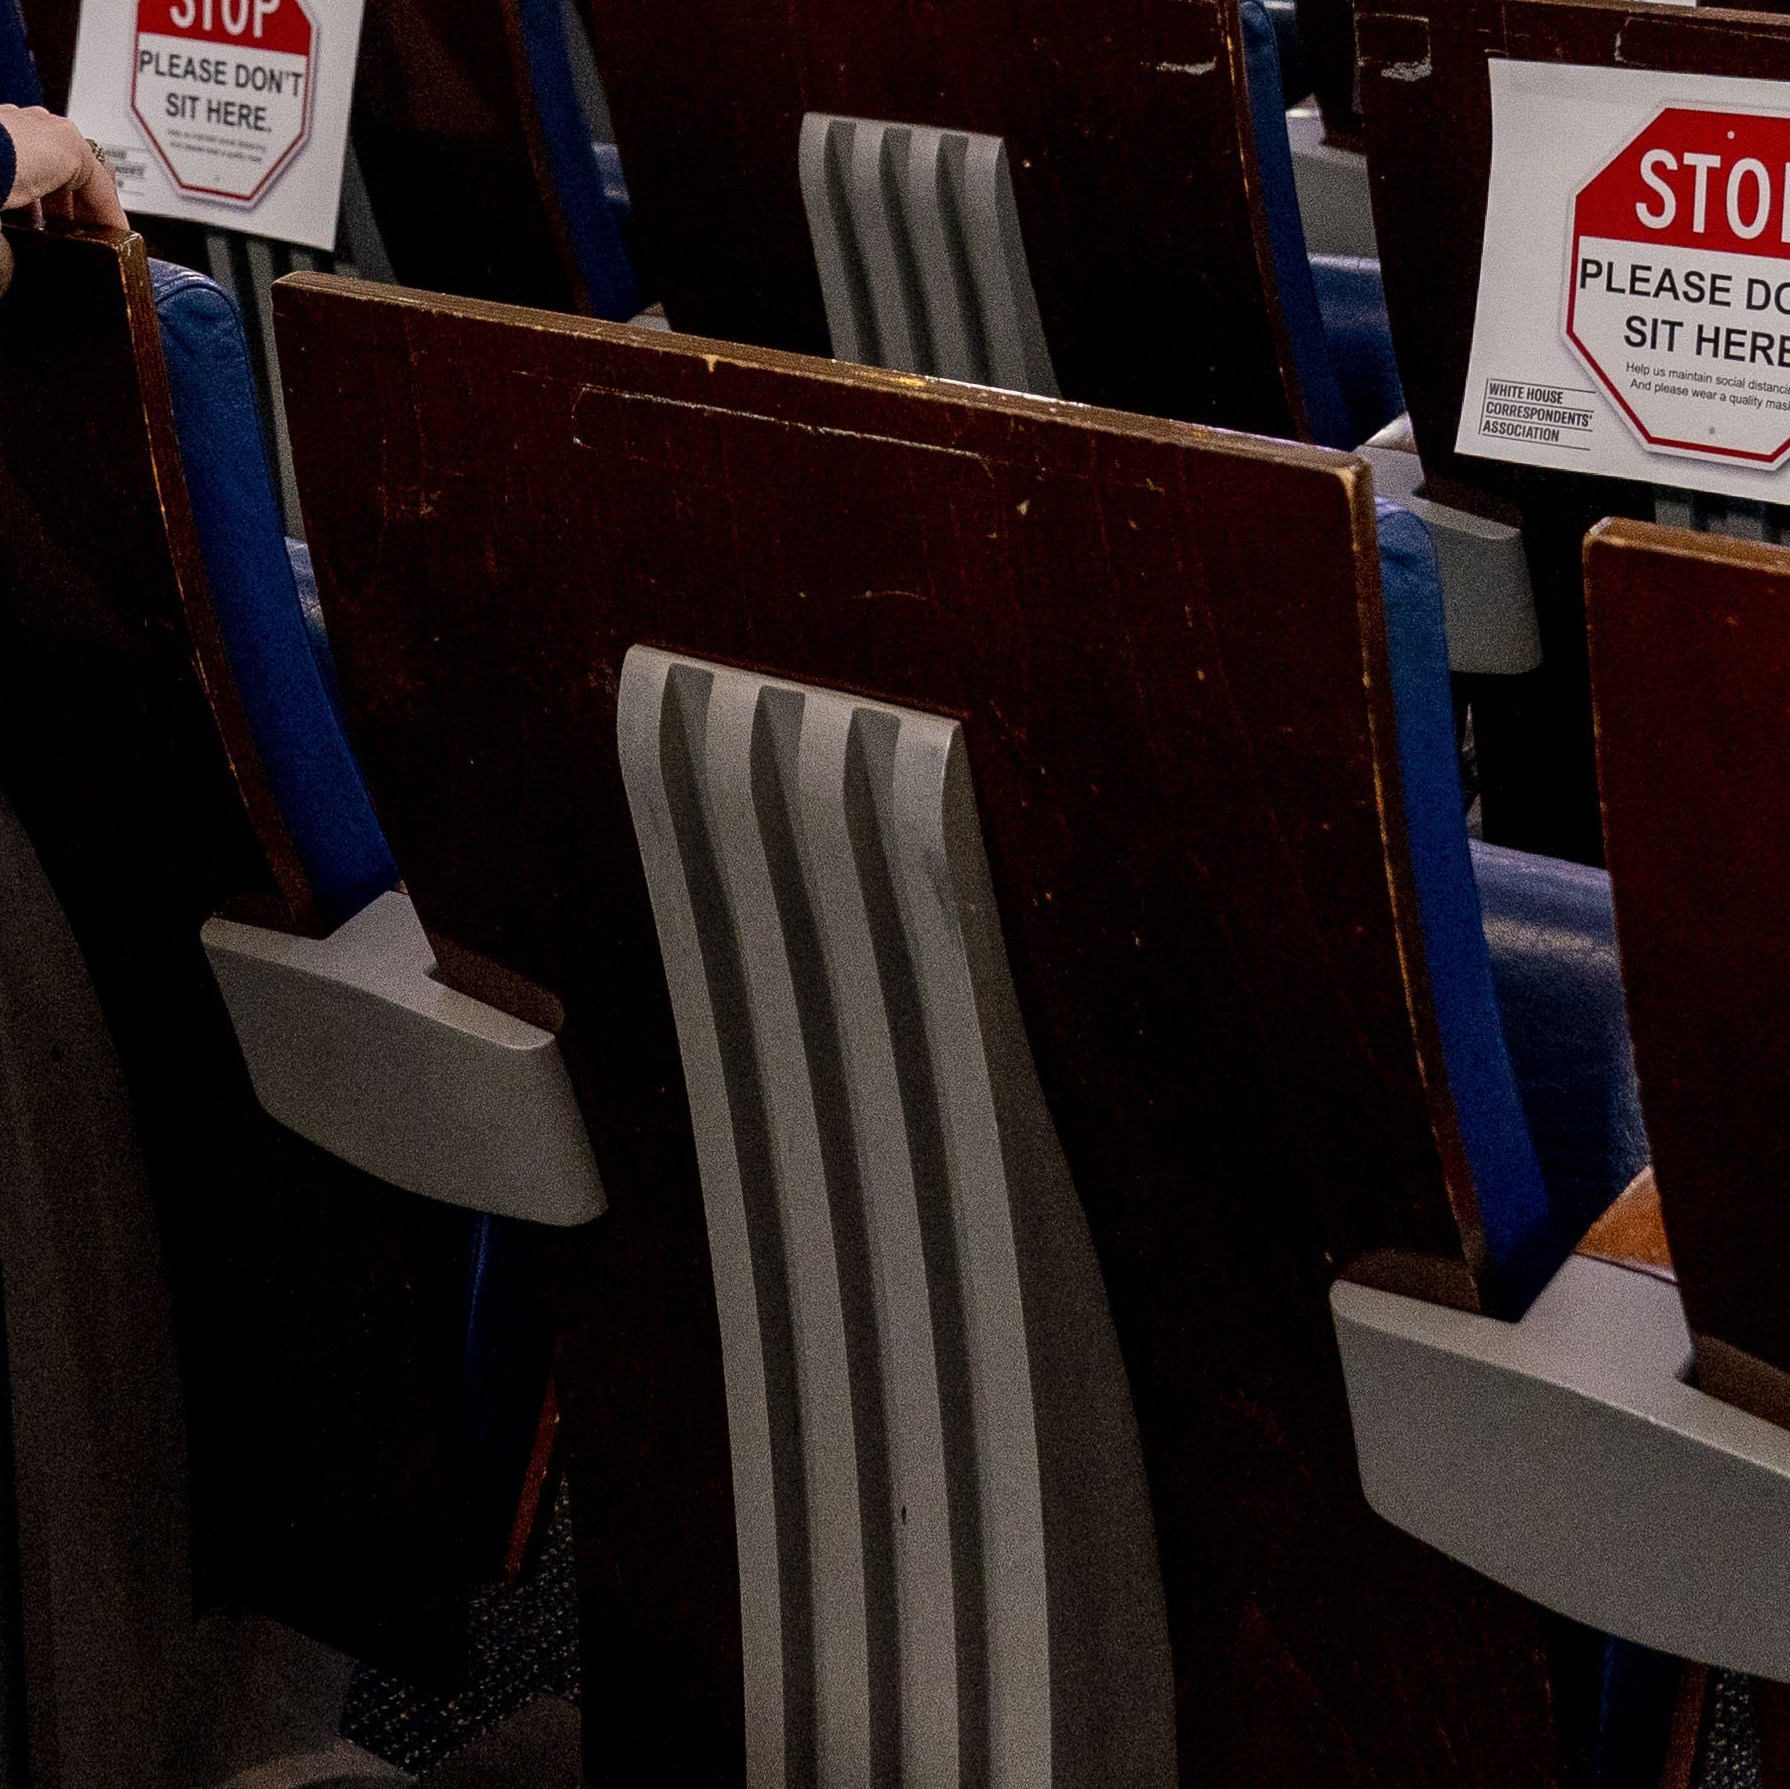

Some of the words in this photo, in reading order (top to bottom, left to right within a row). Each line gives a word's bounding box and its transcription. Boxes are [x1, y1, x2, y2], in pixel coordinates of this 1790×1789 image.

[139, 50, 228, 86] PLEASE
[235, 63, 304, 97] DON'T
[165, 92, 199, 120] SIT
[206, 100, 271, 133] HERE.
[1579, 258, 1732, 308] PLEASE
[1624, 315, 1683, 352] SIT
[1626, 362, 1650, 376] Help
[1653, 368, 1666, 378] us
[1668, 369, 1712, 384] maintain
[1715, 376, 1746, 389] social
[1489, 382, 1525, 400] WHITE
[1526, 387, 1564, 405] HOUSE
[1630, 378, 1651, 391] And
[1654, 381, 1688, 396] please
[1691, 388, 1717, 401] wear
[1729, 393, 1763, 410] quality
[1486, 401, 1592, 427] CORRESPONDENTS'
[1483, 419, 1560, 443] ASSOCIATION
